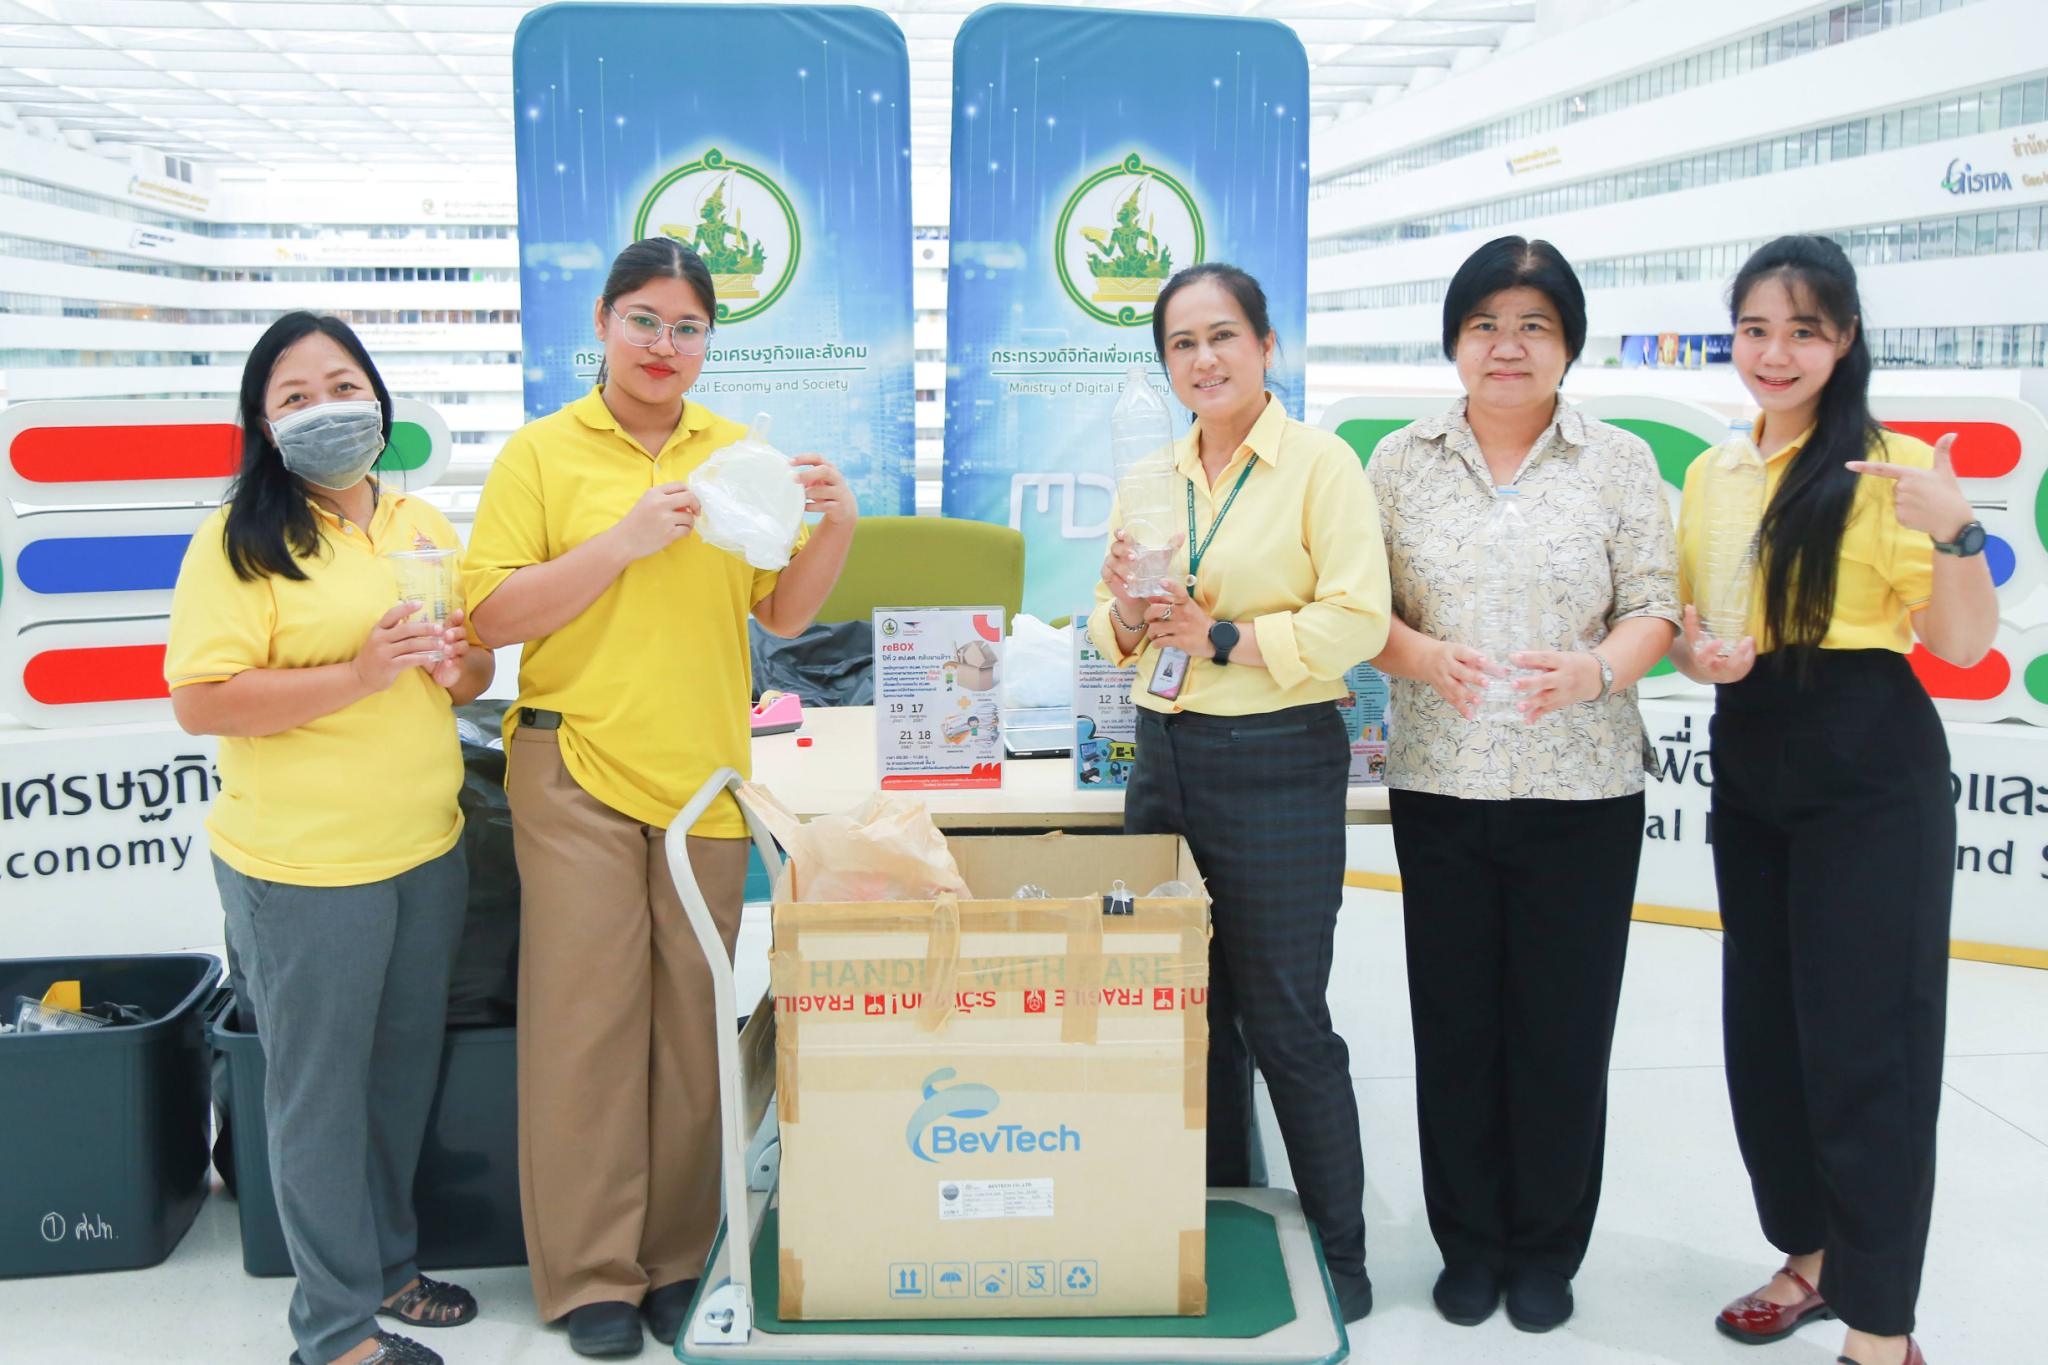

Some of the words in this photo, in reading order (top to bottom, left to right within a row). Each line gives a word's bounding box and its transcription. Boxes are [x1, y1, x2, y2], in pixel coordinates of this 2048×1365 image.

[714, 380, 771, 394] Economy
[775, 380, 798, 392] and
[803, 378, 849, 392] Society
[1009, 382, 1057, 396] Ministry
[1060, 381, 1072, 393] of
[1075, 382, 1114, 395] Digital
[882, 643, 914, 652] reBOX
[1099, 695, 1112, 704] 12
[890, 703, 904, 713] 19
[911, 703, 924, 713] 17
[900, 730, 913, 740] 21
[918, 730, 931, 740] 18
[0, 835, 193, 879] conomy
[1957, 840, 2014, 876] nd
[970, 955, 1065, 987] WITH
[1103, 954, 1174, 986] ARE
[773, 993, 855, 1013] FRAGIL
[932, 1124, 1081, 1154] BevTech
